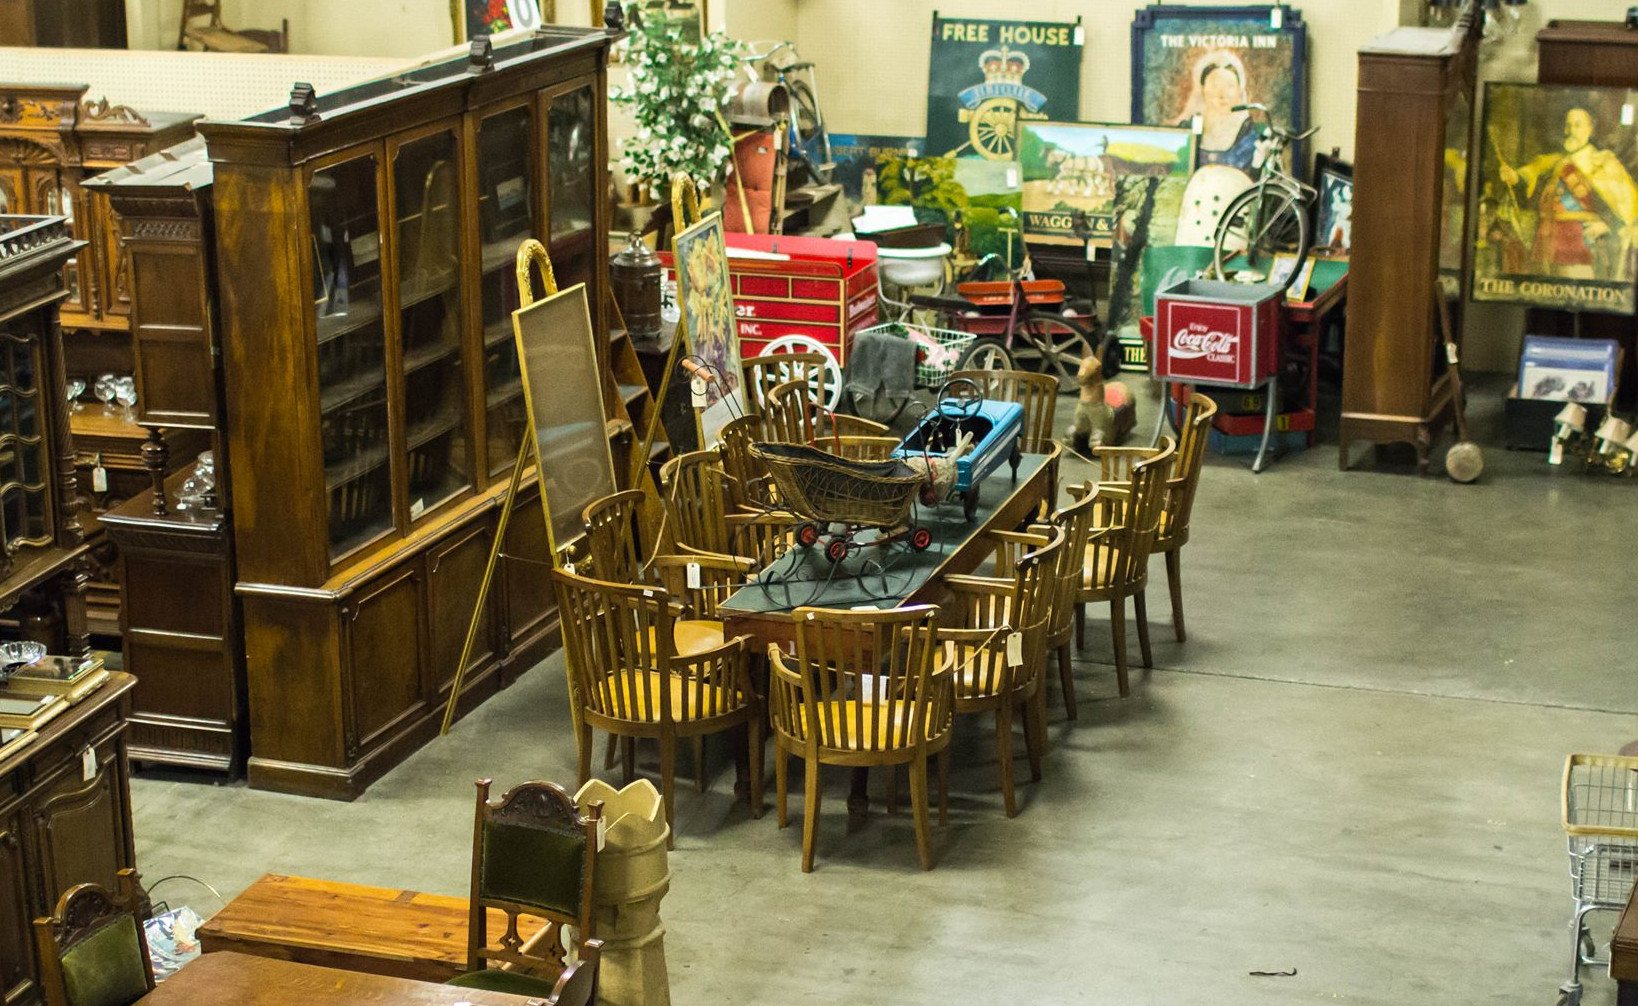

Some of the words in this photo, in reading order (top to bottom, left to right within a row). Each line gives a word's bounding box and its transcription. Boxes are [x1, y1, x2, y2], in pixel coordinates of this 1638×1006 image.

[943, 24, 989, 42] FREE
[1000, 26, 1070, 46] HOUSE
[1160, 35, 1184, 48] THE
[1188, 35, 1250, 48] VICTORIA
[1252, 35, 1278, 49] INN
[1029, 214, 1095, 230] WAGGN
[1096, 218, 1109, 231] &
[1480, 278, 1514, 294] THE
[1520, 281, 1625, 302] CORONATION
